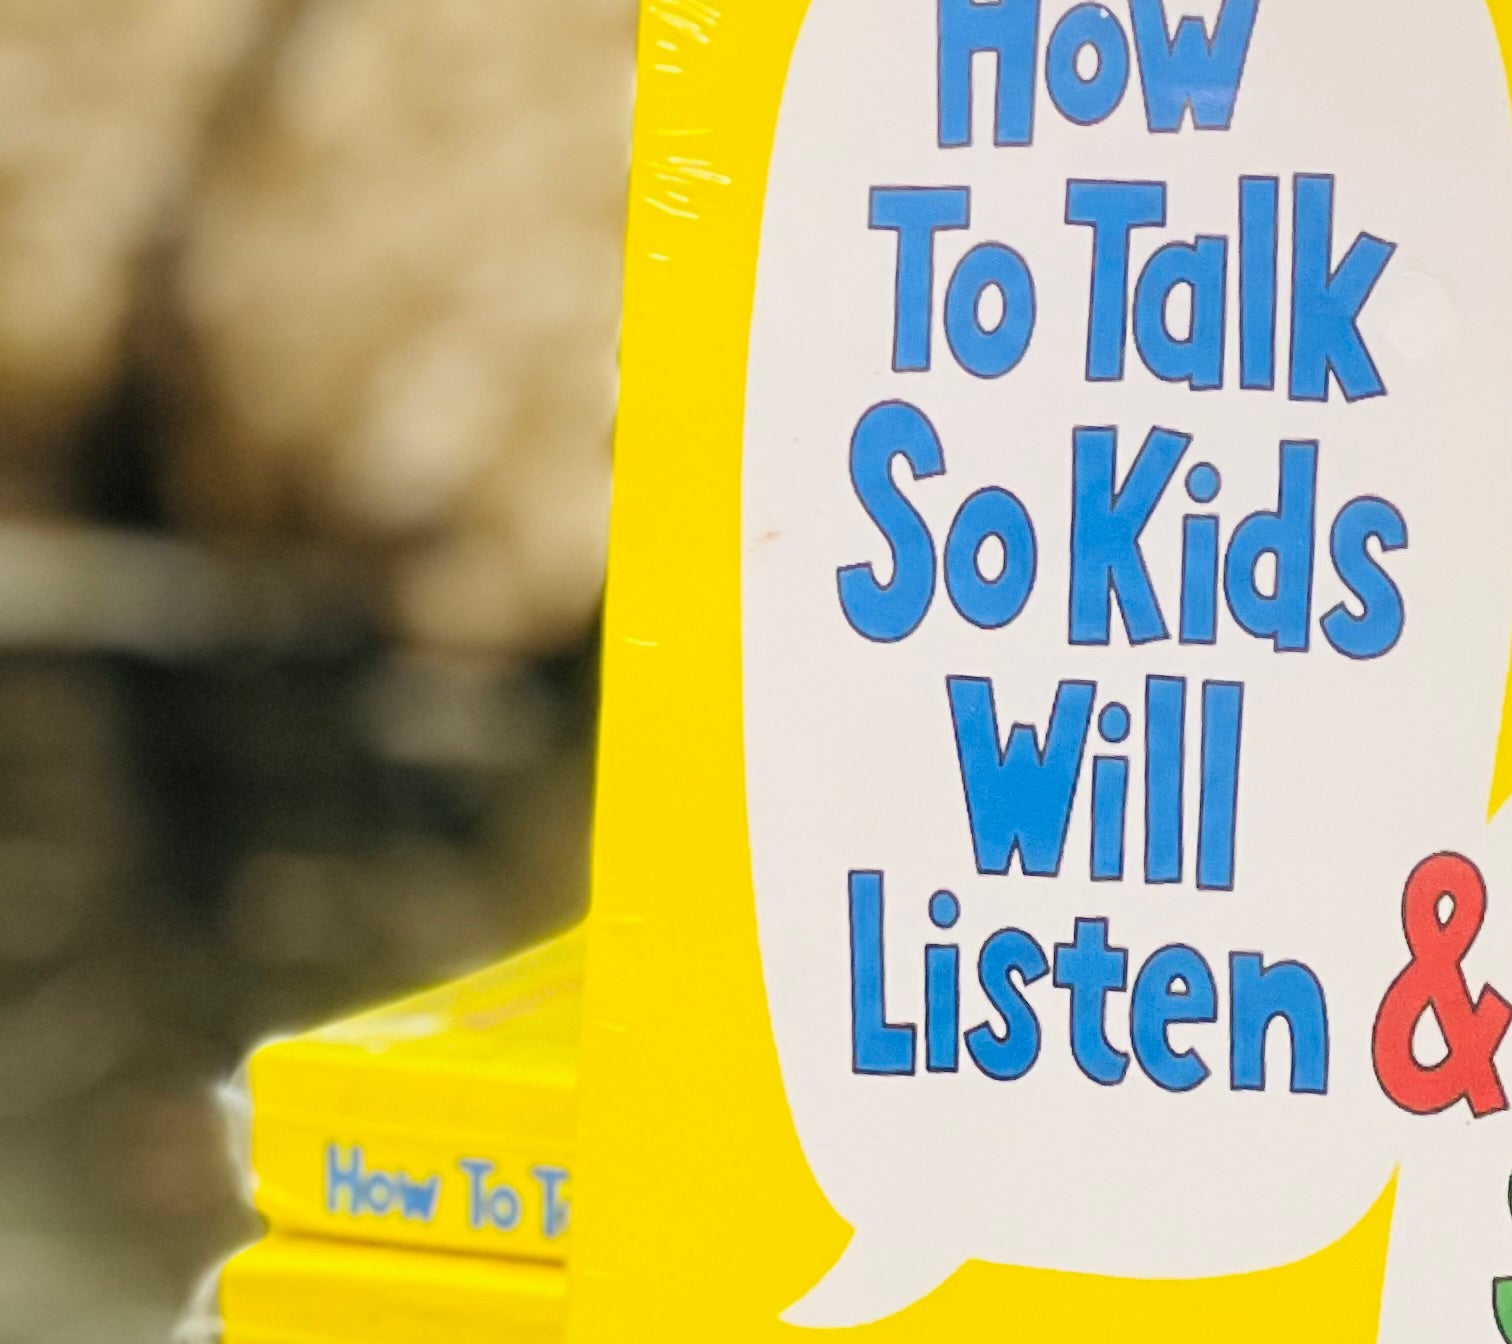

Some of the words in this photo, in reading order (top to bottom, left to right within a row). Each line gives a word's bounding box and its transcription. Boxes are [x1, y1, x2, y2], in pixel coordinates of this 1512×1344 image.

[867, 185, 1037, 380] To
[1064, 171, 1399, 404] Talk
[835, 398, 1038, 644] So
[1068, 424, 1410, 660] Kids
[945, 673, 1245, 892] Will
[847, 868, 1331, 1095] Listen
[324, 1142, 439, 1222] How
[459, 1156, 521, 1230] To
